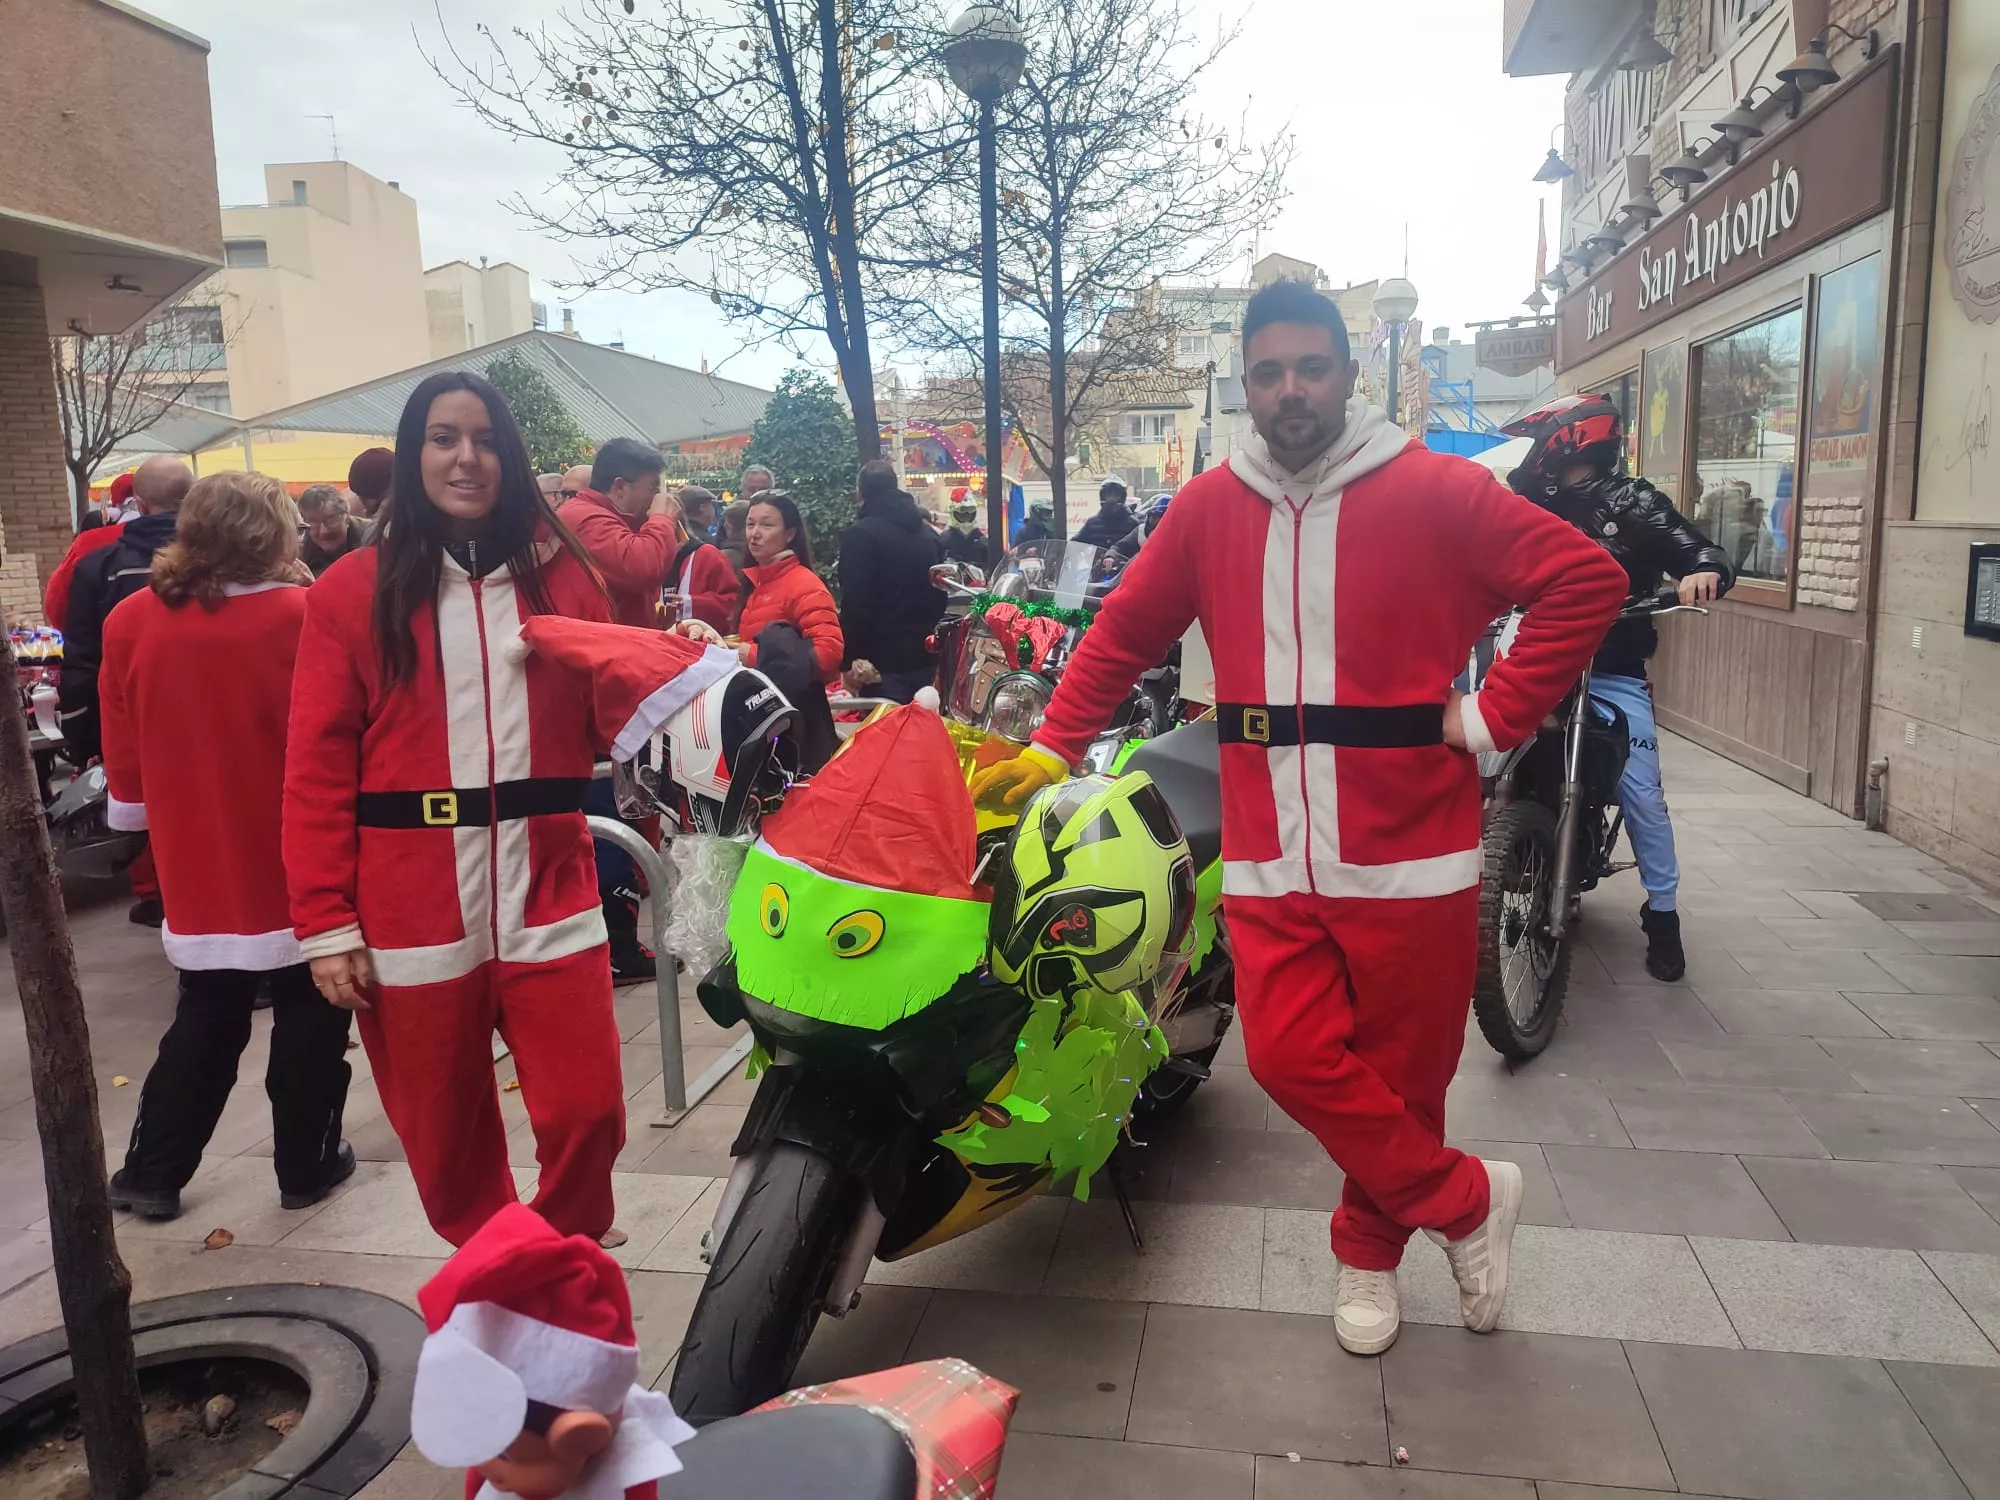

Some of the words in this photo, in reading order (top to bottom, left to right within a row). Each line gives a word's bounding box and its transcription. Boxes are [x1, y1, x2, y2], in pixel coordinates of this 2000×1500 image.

[1586, 285, 1613, 341] Bar
[1638, 245, 1677, 312] San
[1682, 158, 1800, 287] Antonio
[1486, 340, 1546, 358] AMBAR
